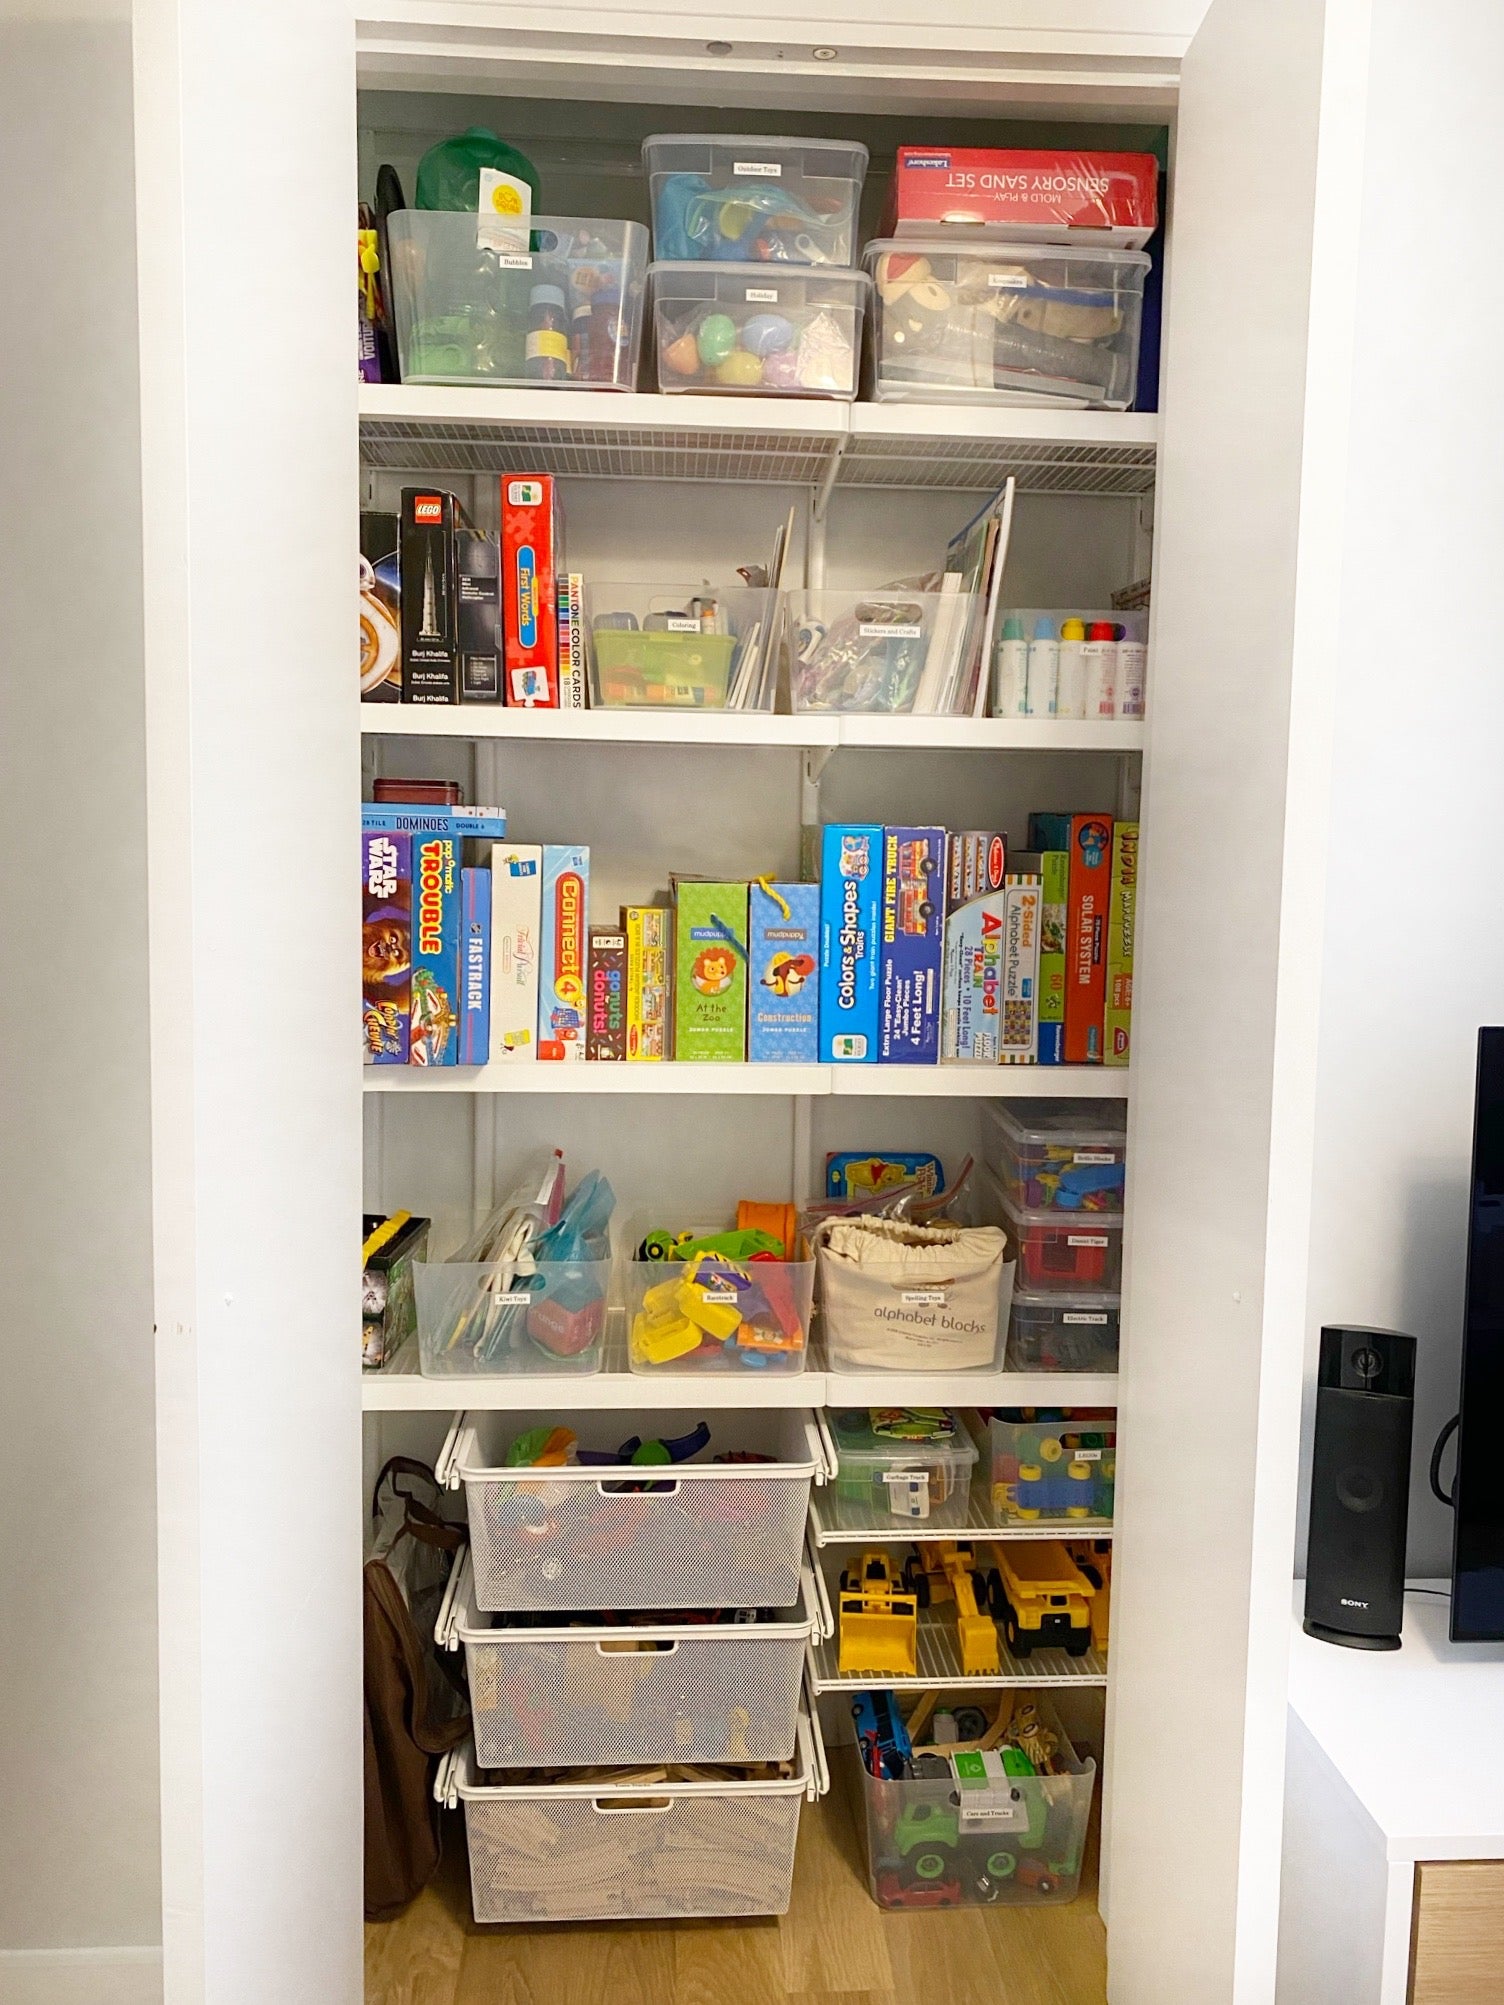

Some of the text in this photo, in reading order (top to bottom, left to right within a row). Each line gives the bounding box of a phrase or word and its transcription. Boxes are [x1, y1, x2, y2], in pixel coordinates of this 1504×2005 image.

[737, 165, 778, 174] Outdoor Toys
[906, 158, 948, 168] Lakeshore
[945, 173, 1109, 192] SENSORY SAND SET
[993, 192, 1061, 203] MOLD & PLAY
[750, 292, 773, 300] Holiday
[416, 504, 441, 516] LEGO
[520, 567, 532, 626] First Words
[671, 621, 697, 631] Coloring
[863, 627, 917, 636] Stickers and Crafts
[569, 575, 582, 708] PANTONE COLOR CARDS
[412, 650, 449, 658] Burj Khalifa
[412, 672, 426, 680] Burj
[412, 695, 450, 703] Burj Khalifa
[396, 817, 449, 831] DOMINOES
[368, 838, 384, 898] WARS
[382, 837, 397, 898] STAR
[1120, 832, 1139, 885] INDIA
[419, 841, 442, 955] TROUBLE
[884, 835, 898, 942] GIANT FIRE TRUCK
[561, 880, 581, 974] Connect
[1021, 895, 1036, 948] 2-Sided
[515, 926, 530, 954] Trivial
[694, 930, 729, 939] mudpup
[767, 930, 805, 940] mudpuppy
[837, 881, 859, 1009] Colors & Shapes
[855, 931, 864, 959] Trains
[870, 922, 878, 945] puzzles
[1079, 895, 1094, 984] SOLAR SYSTEM
[1007, 905, 1021, 996] Alphabet Puzzle
[870, 961, 878, 977] giant
[972, 946, 984, 988] TRAIN
[981, 911, 1002, 1014] Alphabet
[467, 938, 483, 1011] FASTRACK
[1050, 973, 1063, 990] 60
[560, 980, 578, 994] 4
[960, 946, 973, 1049] 28 Pieces 10 Feet Long!
[593, 970, 608, 1034] donuts!
[696, 1003, 727, 1013] At the
[882, 959, 893, 1056] Extra Large Floor Puzzle
[902, 980, 911, 1036] Jumbo Pieces
[911, 970, 926, 1045] 4 Feet Long!
[703, 1013, 721, 1022] Zoo
[757, 1012, 812, 1023] Construction
[893, 1028, 901, 1040] 24
[973, 1032, 982, 1058] PUZZL
[1053, 1024, 1062, 1062] Ravensburger
[514, 1296, 527, 1304] Toys
[928, 1295, 941, 1303] Toys
[874, 1306, 986, 1334] alphabet blocks
[886, 1474, 909, 1482] Garbage
[1340, 1598, 1369, 1609] SONY
